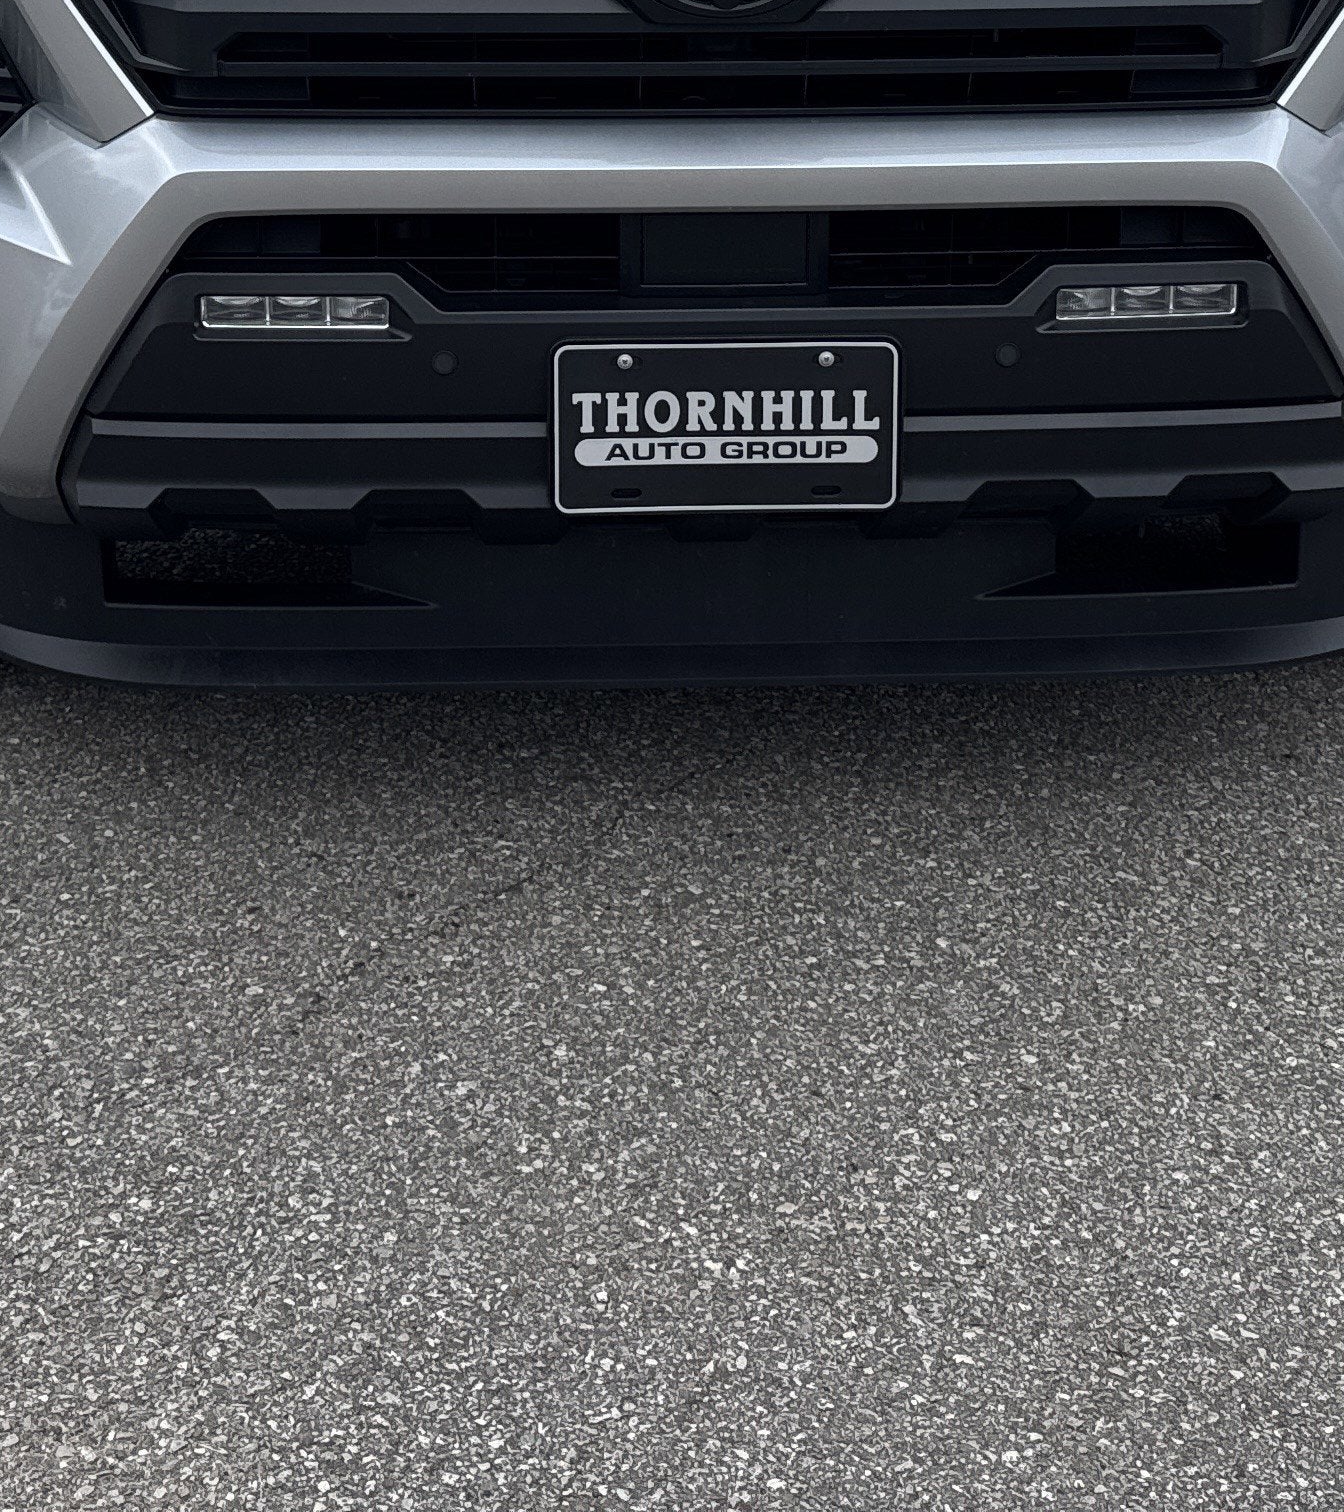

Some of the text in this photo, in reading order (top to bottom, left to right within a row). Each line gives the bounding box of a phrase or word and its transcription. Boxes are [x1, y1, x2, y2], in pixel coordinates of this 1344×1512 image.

[571, 389, 880, 434] THORNHILL
[604, 440, 848, 462] AUTO GROUP
